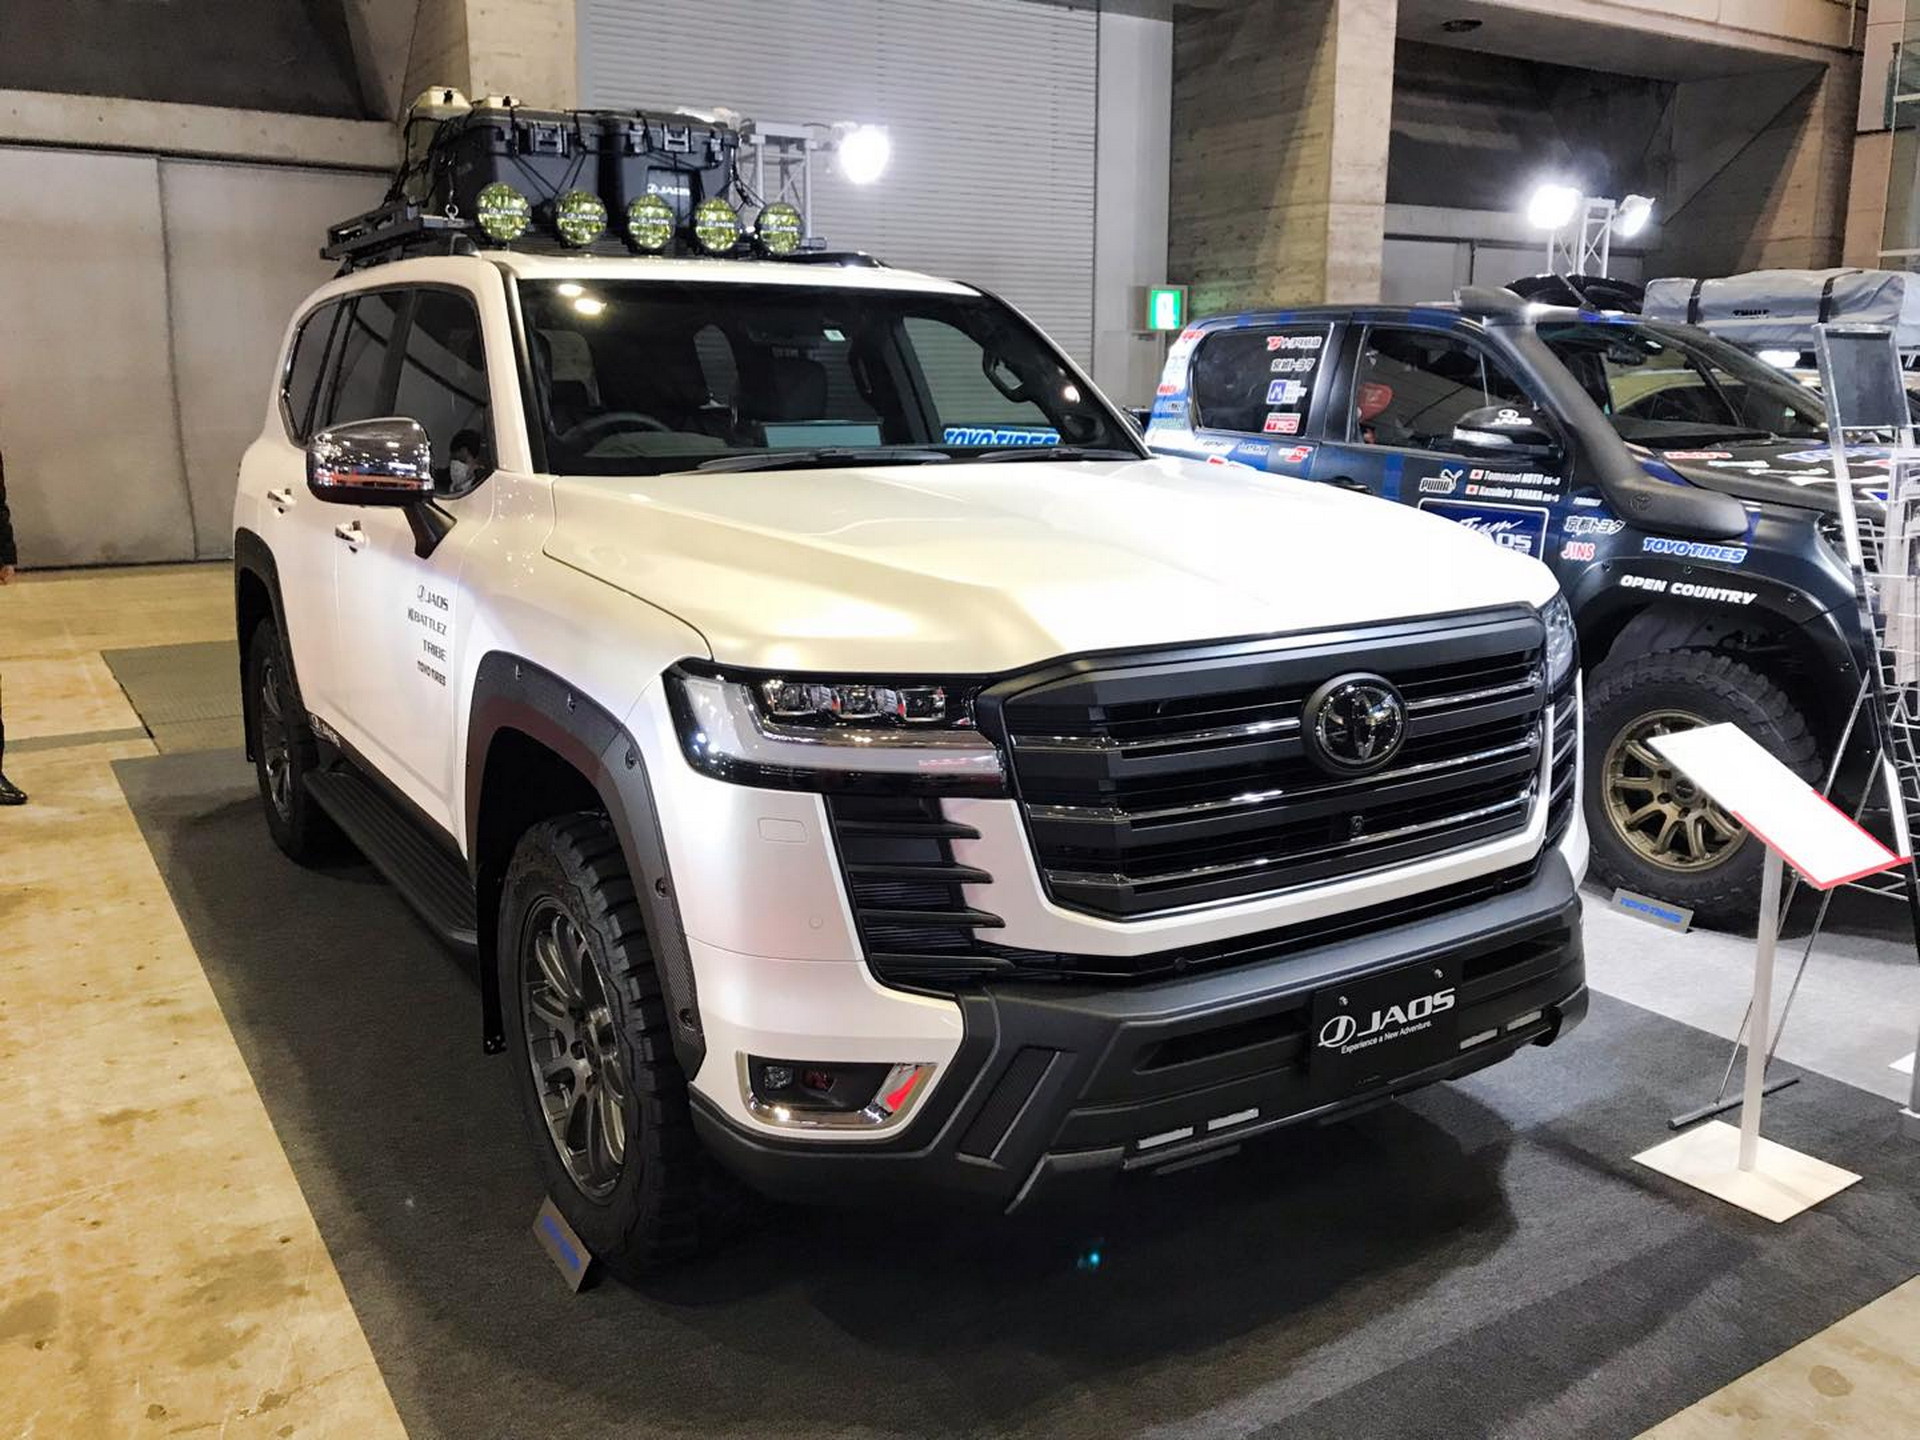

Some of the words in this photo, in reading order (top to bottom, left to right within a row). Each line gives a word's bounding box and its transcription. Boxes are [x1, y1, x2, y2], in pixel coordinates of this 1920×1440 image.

[1419, 477, 1451, 493] PUMA
[1564, 515, 1626, 534] 京都トヨタ
[1561, 541, 1595, 561] JINS
[1620, 574, 1668, 593] OPEN
[1669, 582, 1758, 605] COUNTRY
[422, 639, 447, 662] TRIBE
[1357, 987, 1456, 1037] JAOS
[1340, 1037, 1378, 1055] Experience
[1383, 1030, 1400, 1042] New
